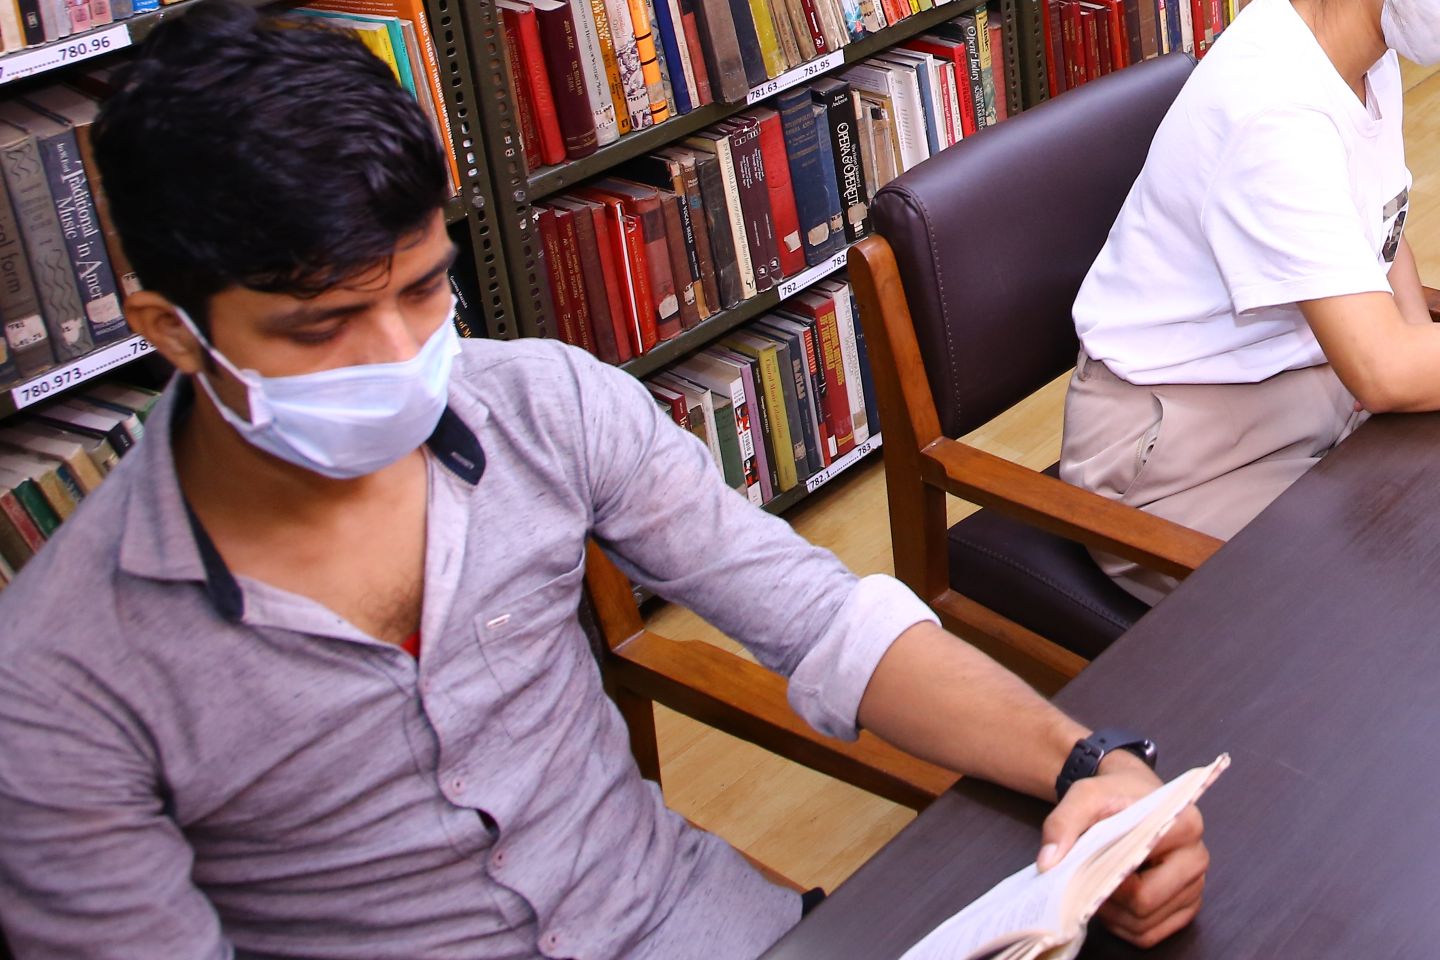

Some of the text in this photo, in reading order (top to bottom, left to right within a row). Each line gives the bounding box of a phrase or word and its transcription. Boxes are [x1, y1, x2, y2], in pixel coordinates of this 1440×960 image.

[58, 36, 111, 60] 780.96
[417, 11, 457, 161] MUSIC THEORY THROUGH IMPROVISATION
[750, 59, 831, 100] 781.63 781.95
[837, 122, 851, 157] OPERA
[55, 196, 79, 240] Music
[61, 160, 100, 258] Traditional in
[782, 281, 798, 296] 782
[21, 369, 82, 402] 780.973
[810, 442, 872, 488] 782.1 783
